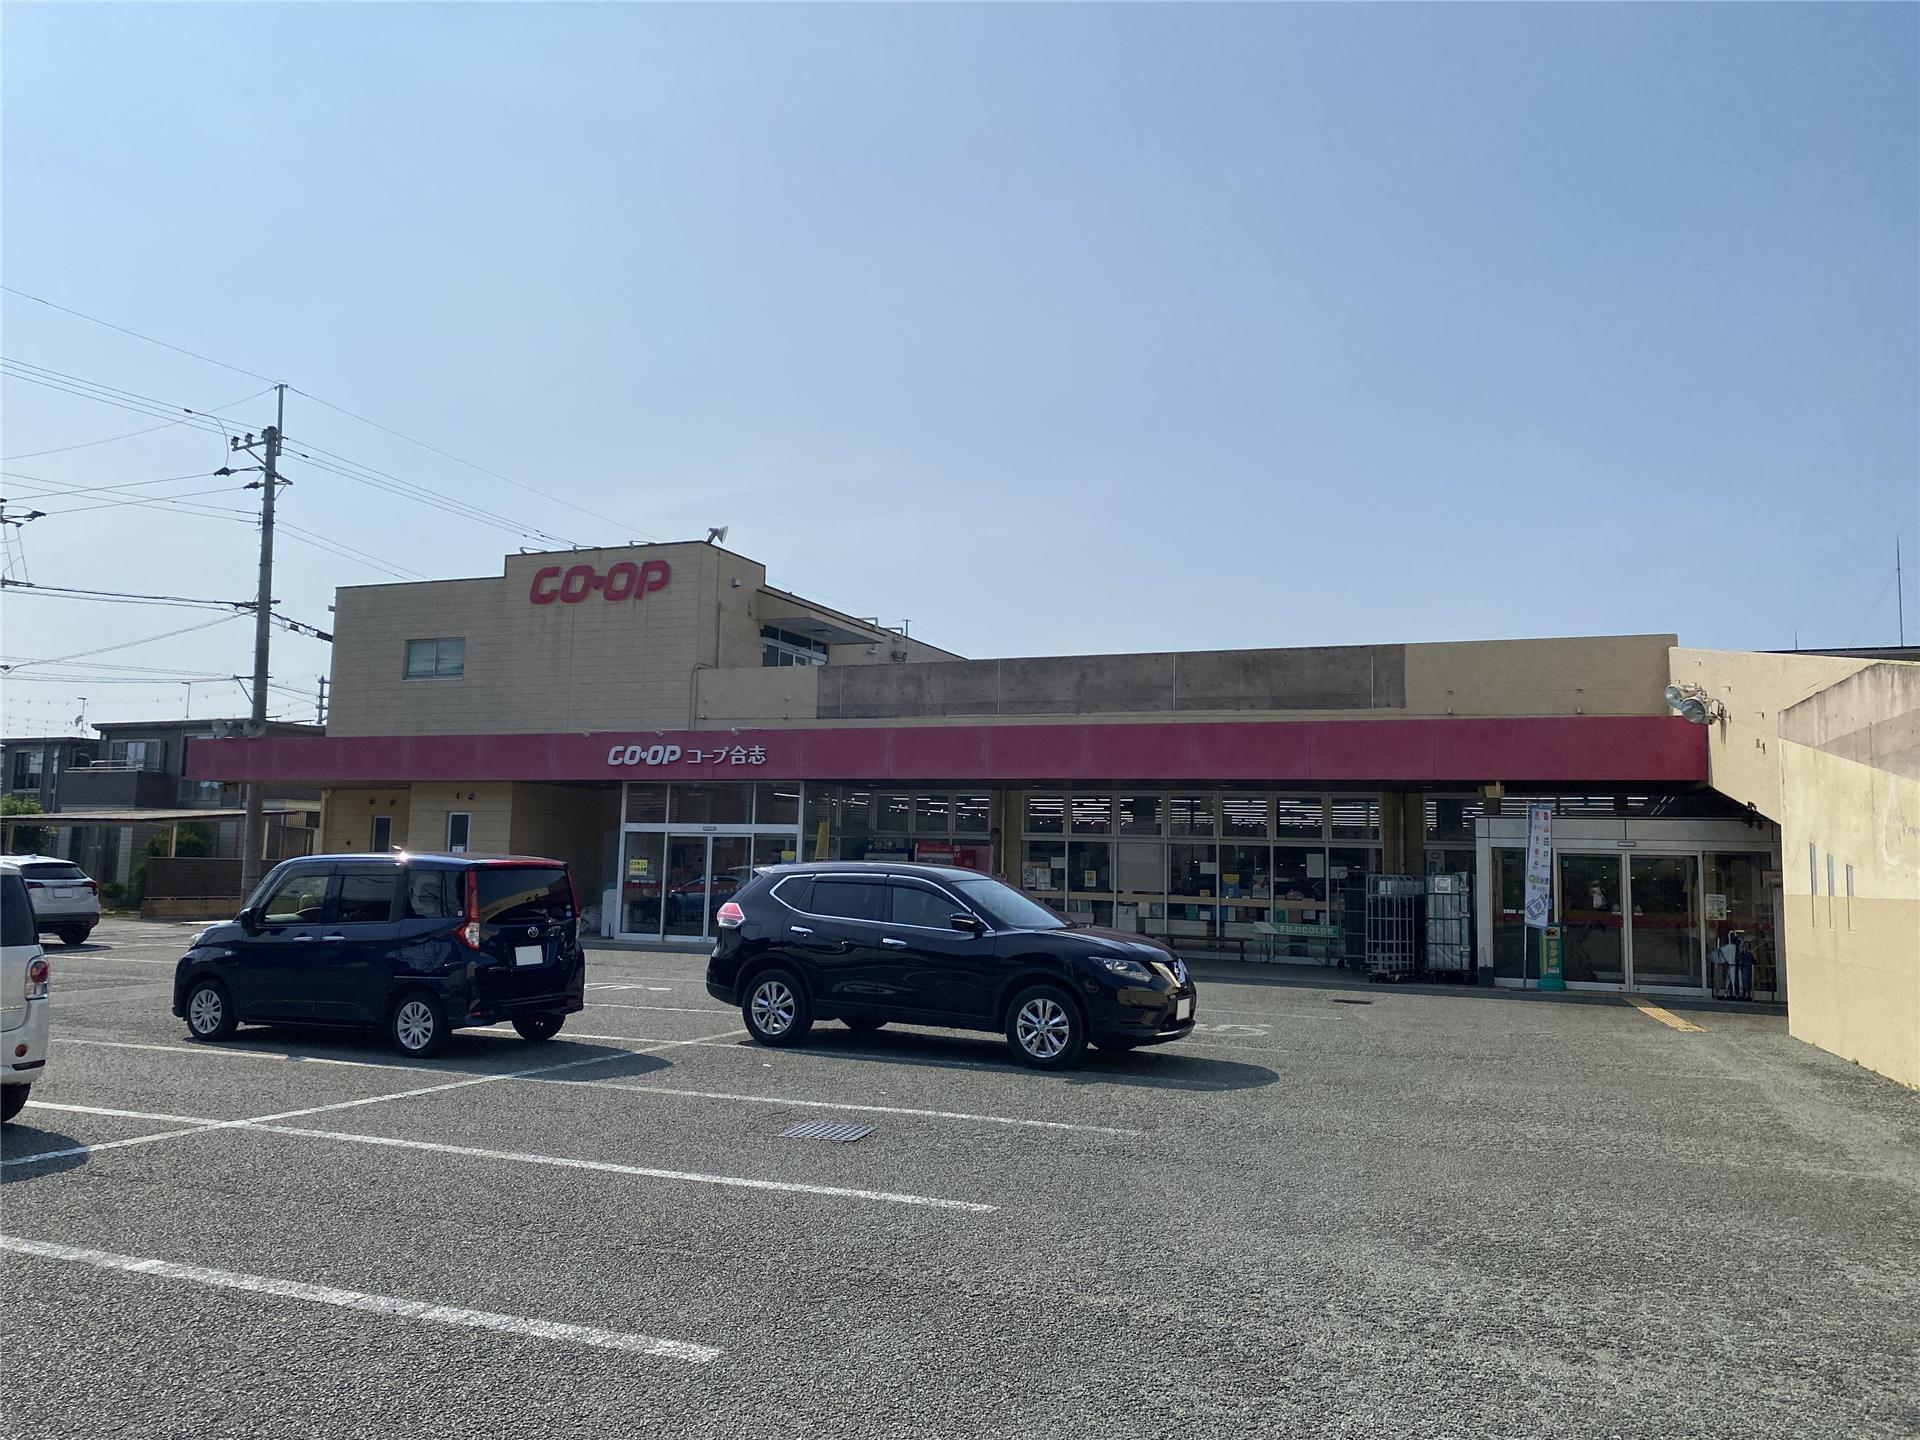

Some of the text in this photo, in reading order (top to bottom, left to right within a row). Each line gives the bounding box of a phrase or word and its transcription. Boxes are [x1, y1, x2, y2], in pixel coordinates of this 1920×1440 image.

[686, 745, 767, 765] コープ合志
[1280, 925, 1334, 936] FUJICOLOR
